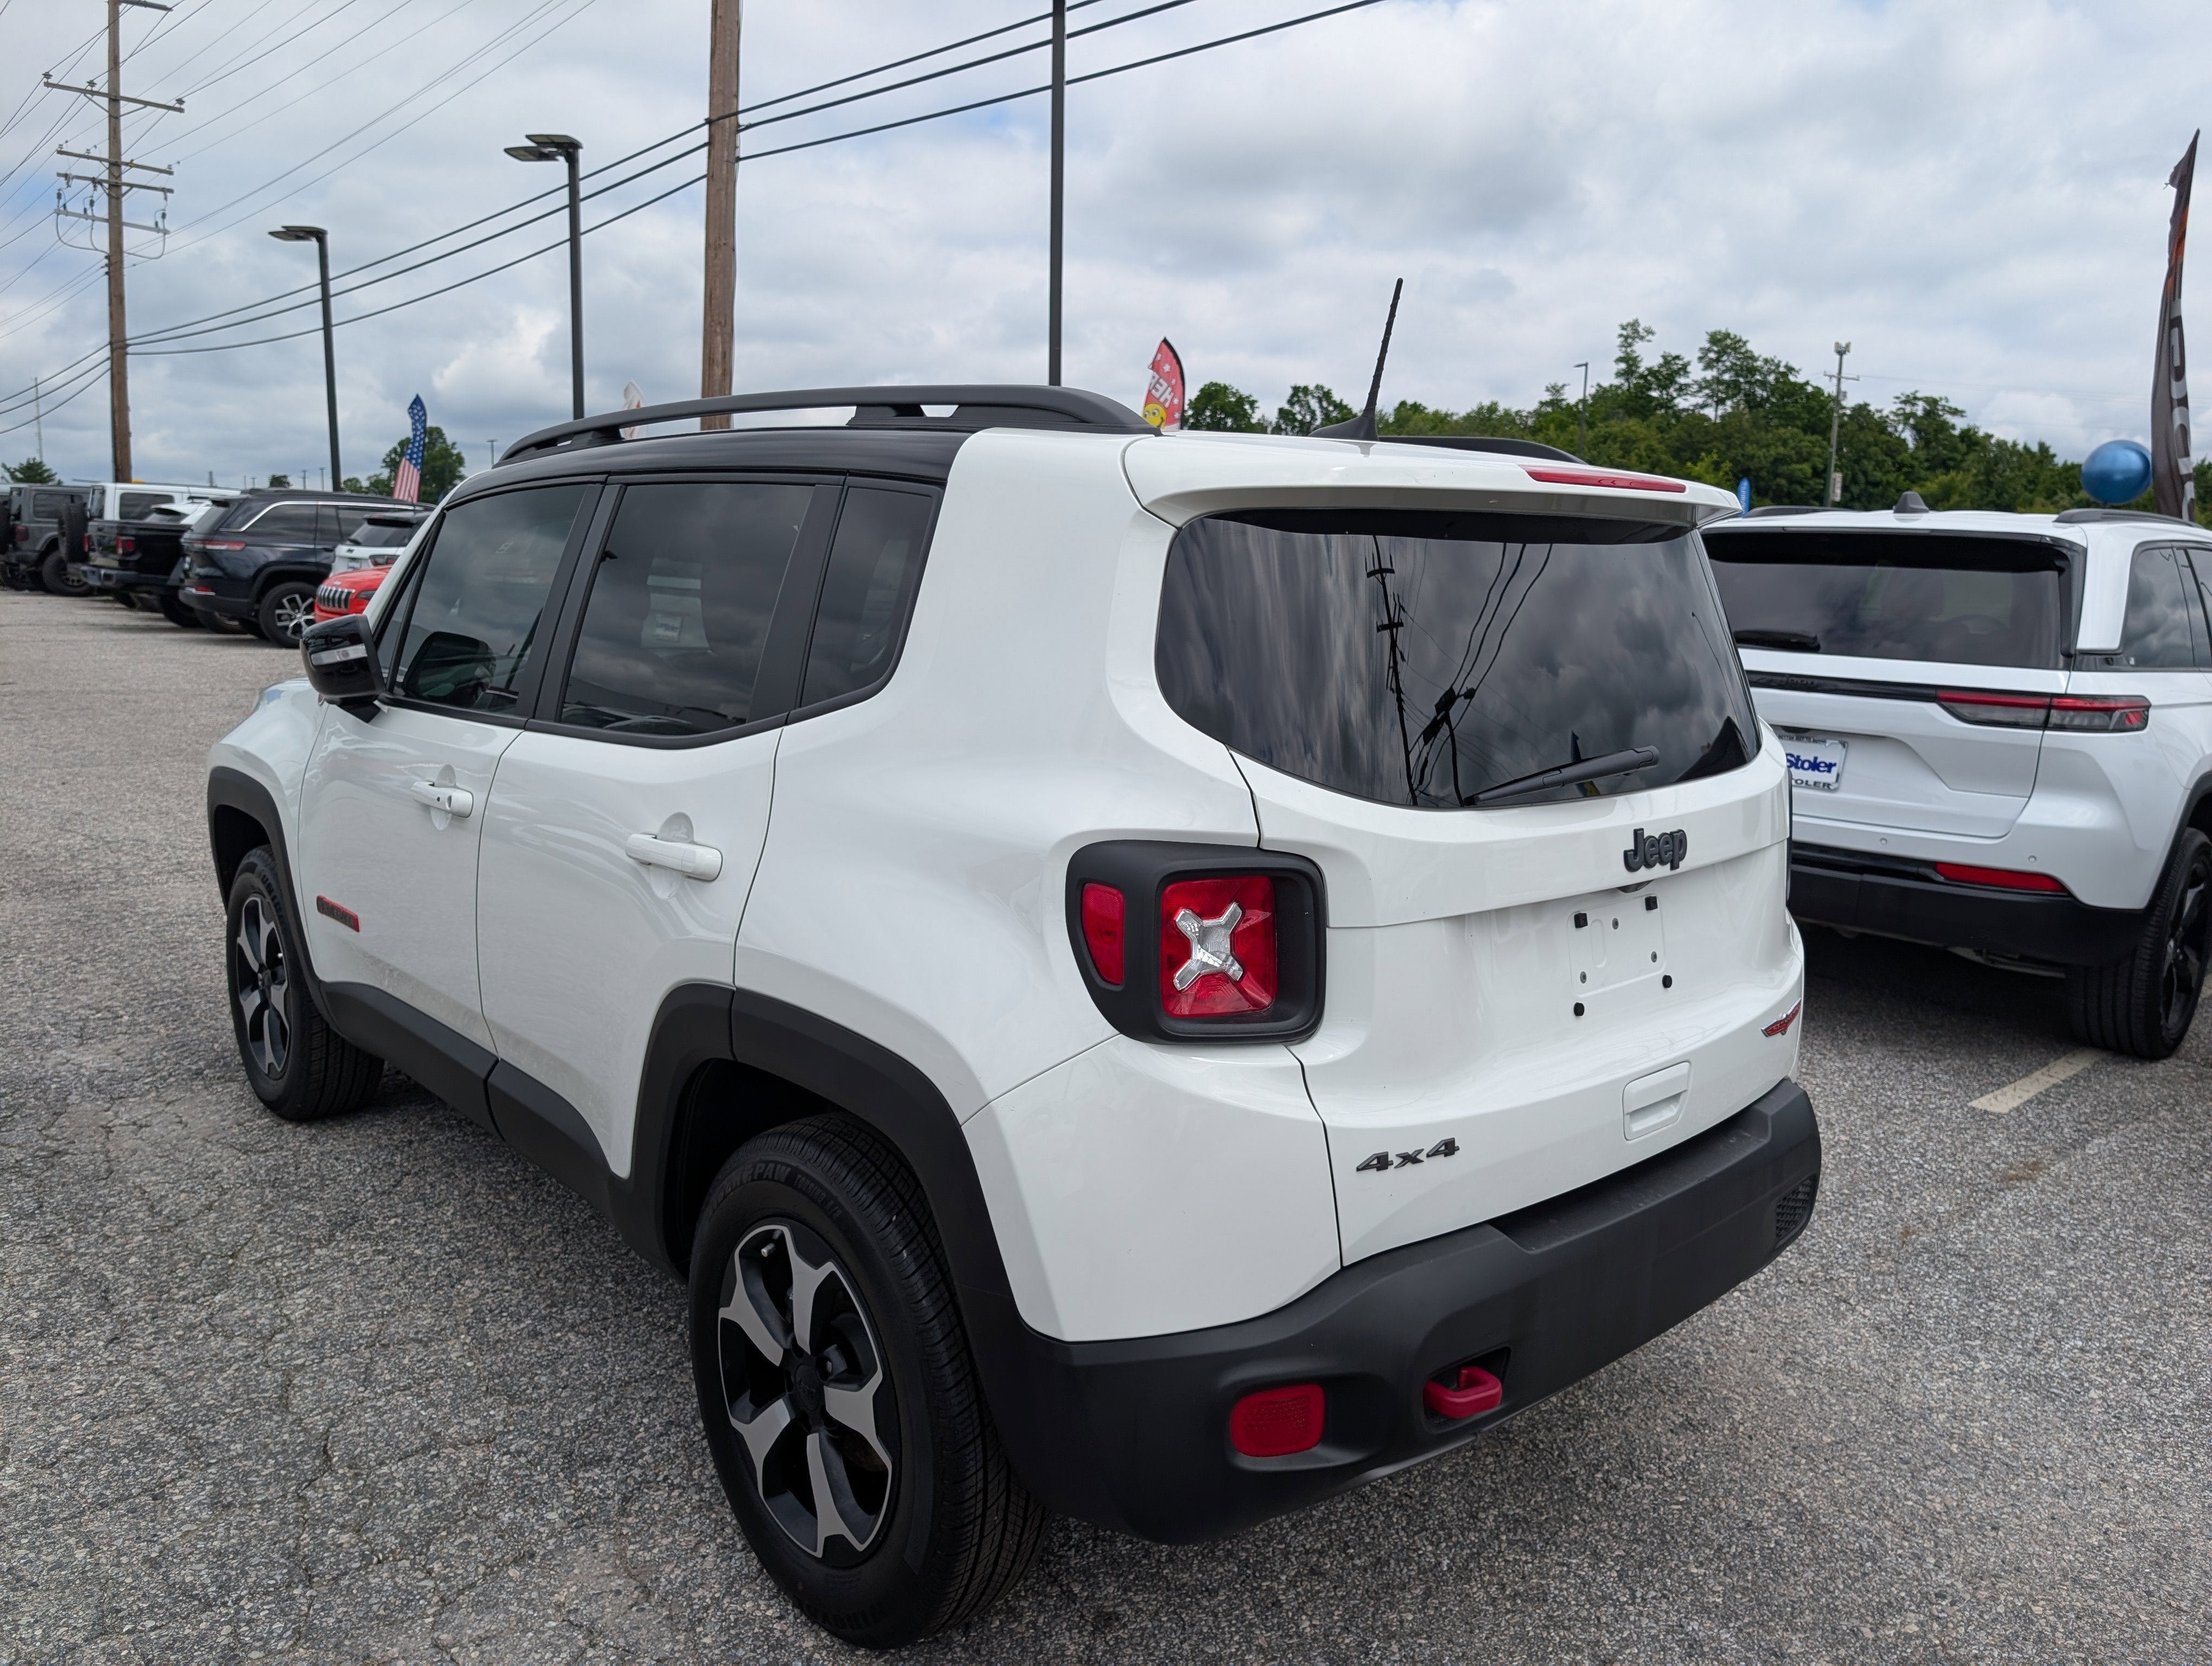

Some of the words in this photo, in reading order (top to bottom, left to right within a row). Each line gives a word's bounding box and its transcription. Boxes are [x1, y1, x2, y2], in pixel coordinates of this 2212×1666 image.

[1785, 753, 1837, 773] Stoler
[1792, 778, 1831, 790] OLER
[1624, 828, 1687, 872] Jeep
[1356, 1137, 1459, 1171] 4x4
